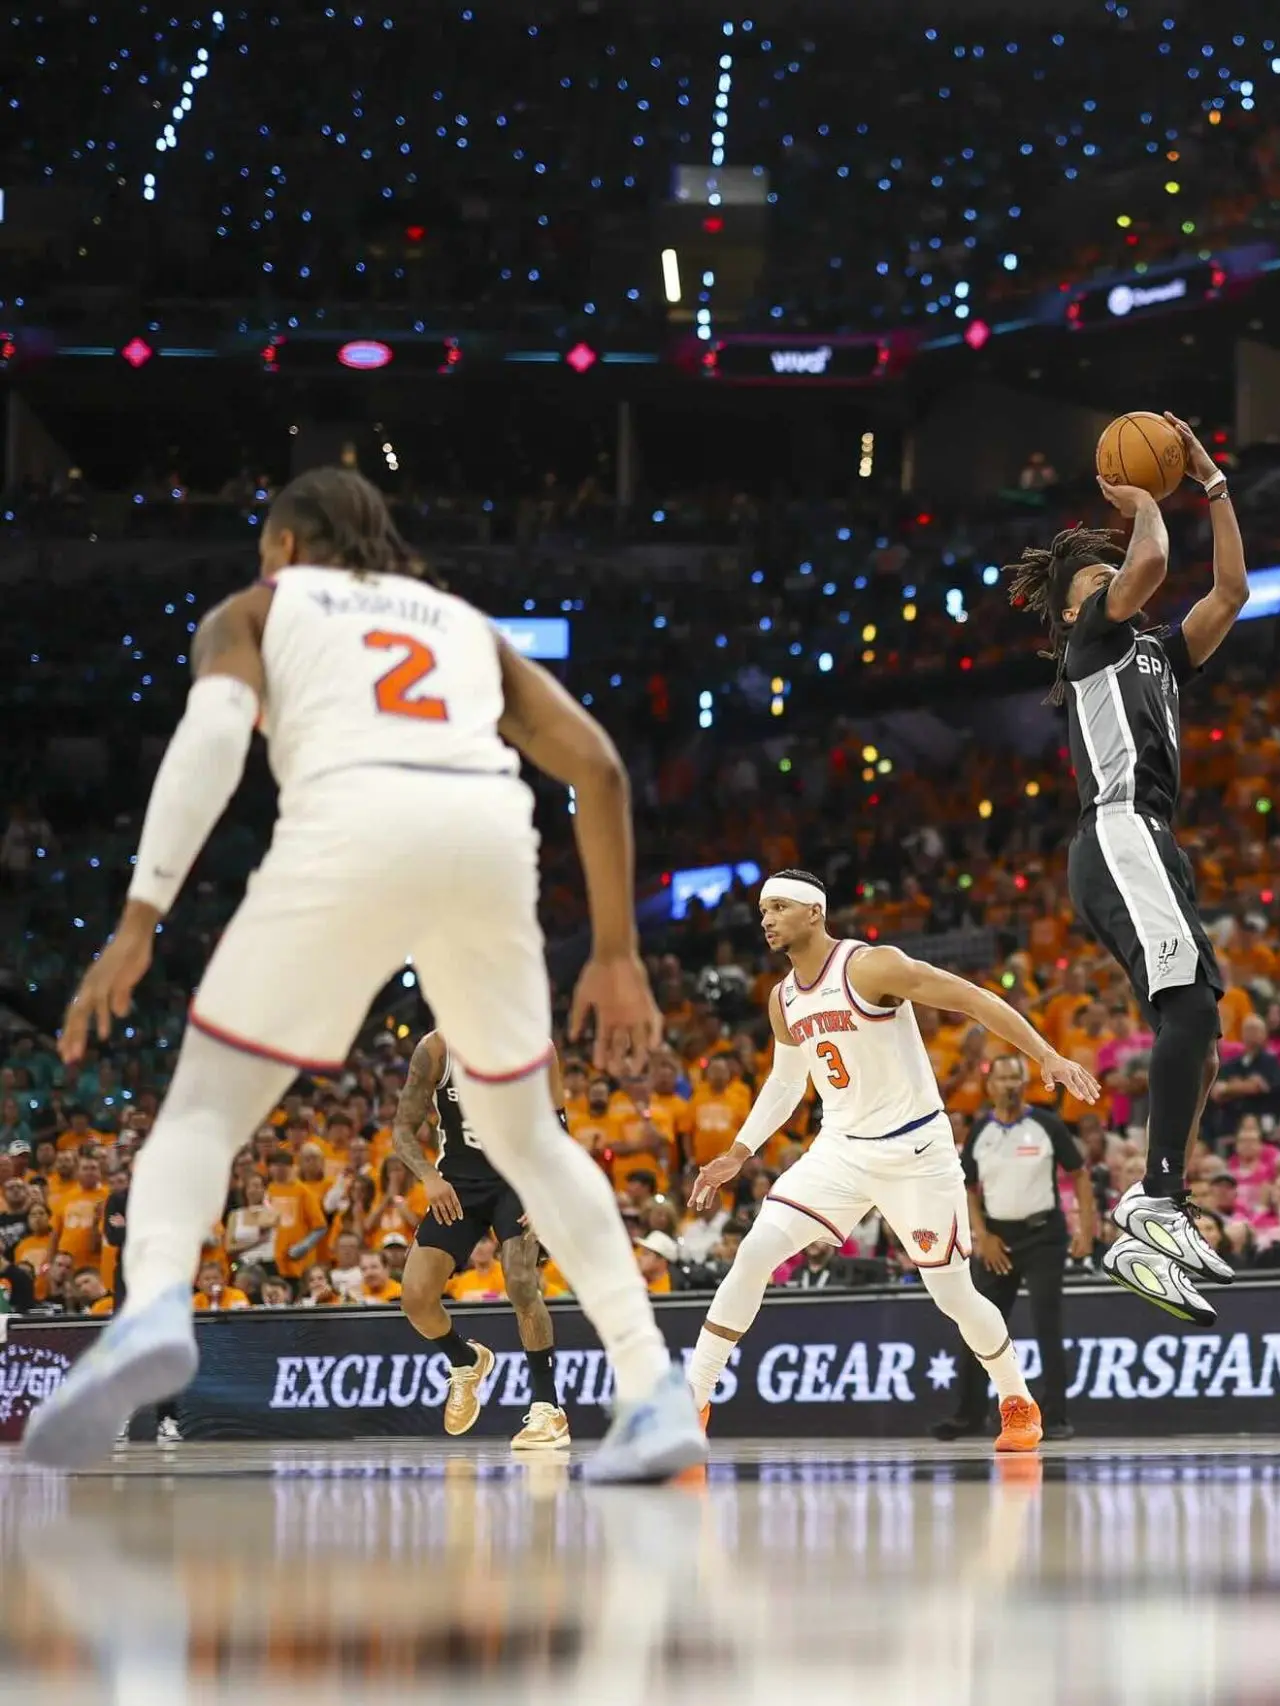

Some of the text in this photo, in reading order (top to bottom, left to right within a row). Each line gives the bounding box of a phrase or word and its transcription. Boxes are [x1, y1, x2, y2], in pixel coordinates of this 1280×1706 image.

[362, 629, 449, 723] 2
[816, 1040, 850, 1089] 3
[269, 1350, 532, 1408] EXCLUSVE
[757, 1342, 916, 1403] GEAR
